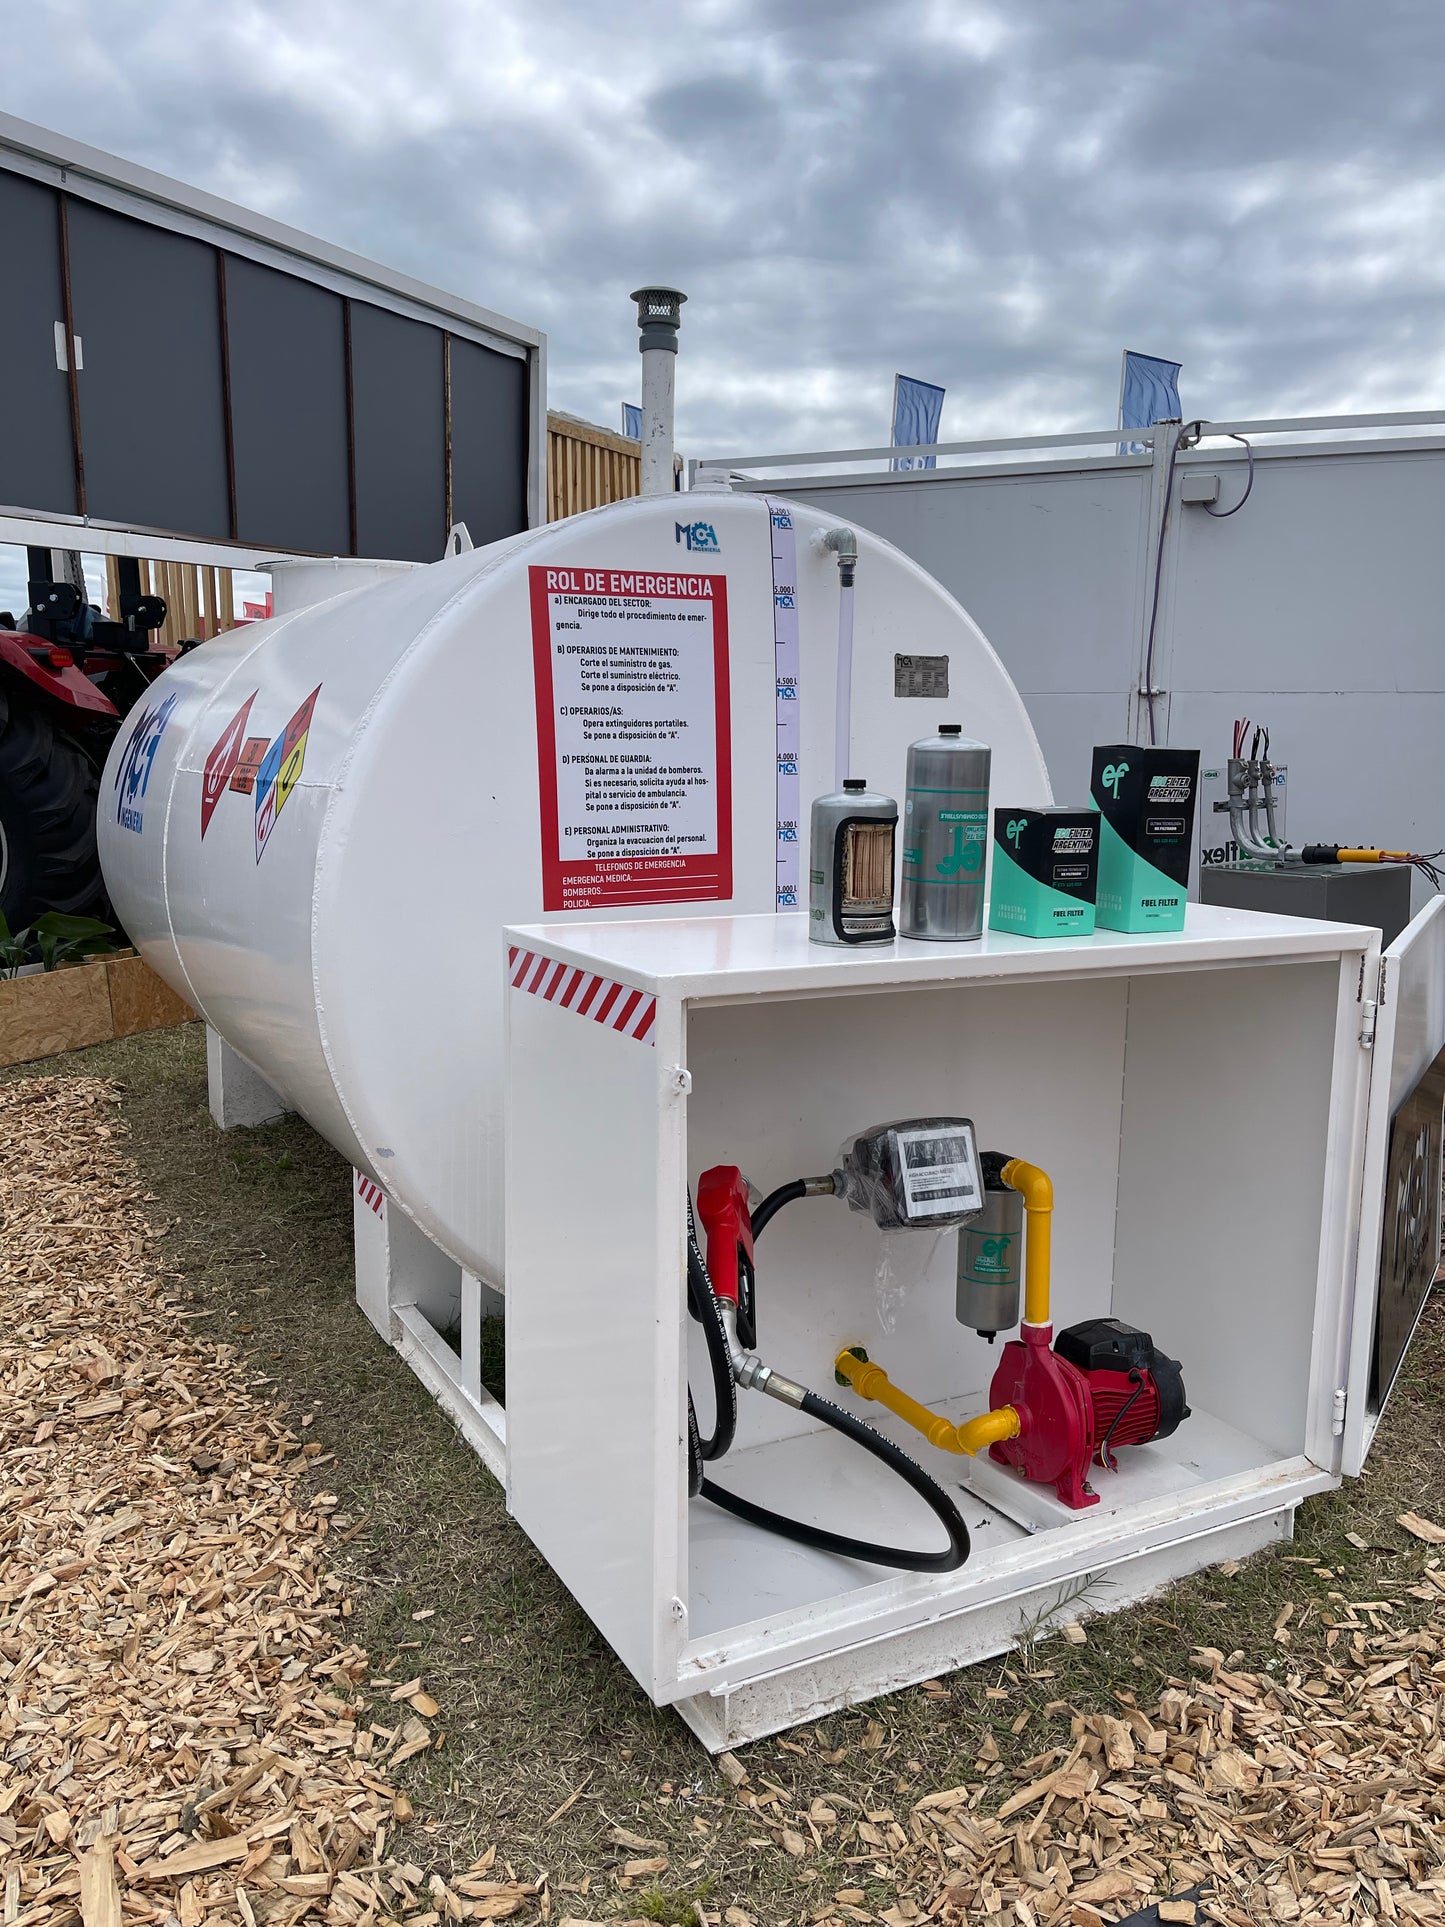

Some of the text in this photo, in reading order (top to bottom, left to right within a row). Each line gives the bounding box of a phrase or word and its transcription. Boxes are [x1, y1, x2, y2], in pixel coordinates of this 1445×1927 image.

[675, 521, 718, 550] MCA
[546, 570, 714, 596] ROL DE EMERGENCIA
[554, 594, 652, 608] a) ENCARGADO DEL SECTOR:
[776, 596, 794, 608] MCA
[578, 609, 707, 622] Dirige todo el procedimiento de emer-
[556, 621, 582, 630] gencia.
[558, 645, 680, 656] B) OPERARIOS DE MANTENIMIENTO:
[580, 658, 600, 666] Corte
[610, 660, 646, 668] suministro
[648, 660, 656, 668] de
[658, 661, 672, 669] gas.
[580, 670, 600, 678] Corte
[610, 671, 647, 680] suministro
[649, 672, 680, 680] eléctrico.
[592, 684, 609, 692] pone
[616, 683, 656, 692] disposición
[777, 688, 796, 700] MCA
[560, 706, 624, 716] C) OPERARIOS/AS:
[289, 703, 310, 742] 2
[582, 719, 688, 728] Opera extinguidores portatiles.
[594, 732, 611, 740] pone
[618, 731, 657, 740] disposición
[562, 754, 570, 764] D)
[572, 756, 608, 764] PERSONAL
[610, 755, 618, 763] DE
[282, 749, 300, 791] 0
[596, 767, 619, 775] alarma
[634, 766, 658, 774] unidad
[658, 766, 667, 774] de
[668, 766, 703, 774] bomberos.
[779, 763, 797, 775] MCA
[585, 779, 592, 787] Si
[603, 778, 638, 787] necesario,
[640, 778, 664, 786] solicita
[666, 778, 686, 786] ayuda
[694, 777, 708, 785] hos-
[586, 791, 602, 800] pital
[608, 790, 636, 798] servicio
[638, 790, 646, 798] de
[648, 789, 688, 798] ambulancia.
[1148, 788, 1190, 799] ARGENTINA
[586, 803, 594, 811] Se
[596, 804, 613, 812] pone
[620, 802, 658, 811] disposición
[564, 824, 670, 836] E) PERSONAL ADMINISTRATIVO:
[586, 838, 617, 847] Organiza
[666, 835, 676, 843] del
[676, 834, 706, 844] personal.
[778, 830, 796, 842] MCA
[1052, 839, 1094, 850] ARGENTINA
[587, 850, 596, 858] Se
[598, 850, 614, 859] pone
[622, 848, 660, 858] disposición
[595, 860, 686, 872] TELEFONOS DE EMERGENCIA
[778, 894, 796, 906] MCA
[1142, 898, 1178, 907] FUEL FILTER
[711, 1297, 722, 1322] WITH
[688, 1410, 696, 1432] HOSE
